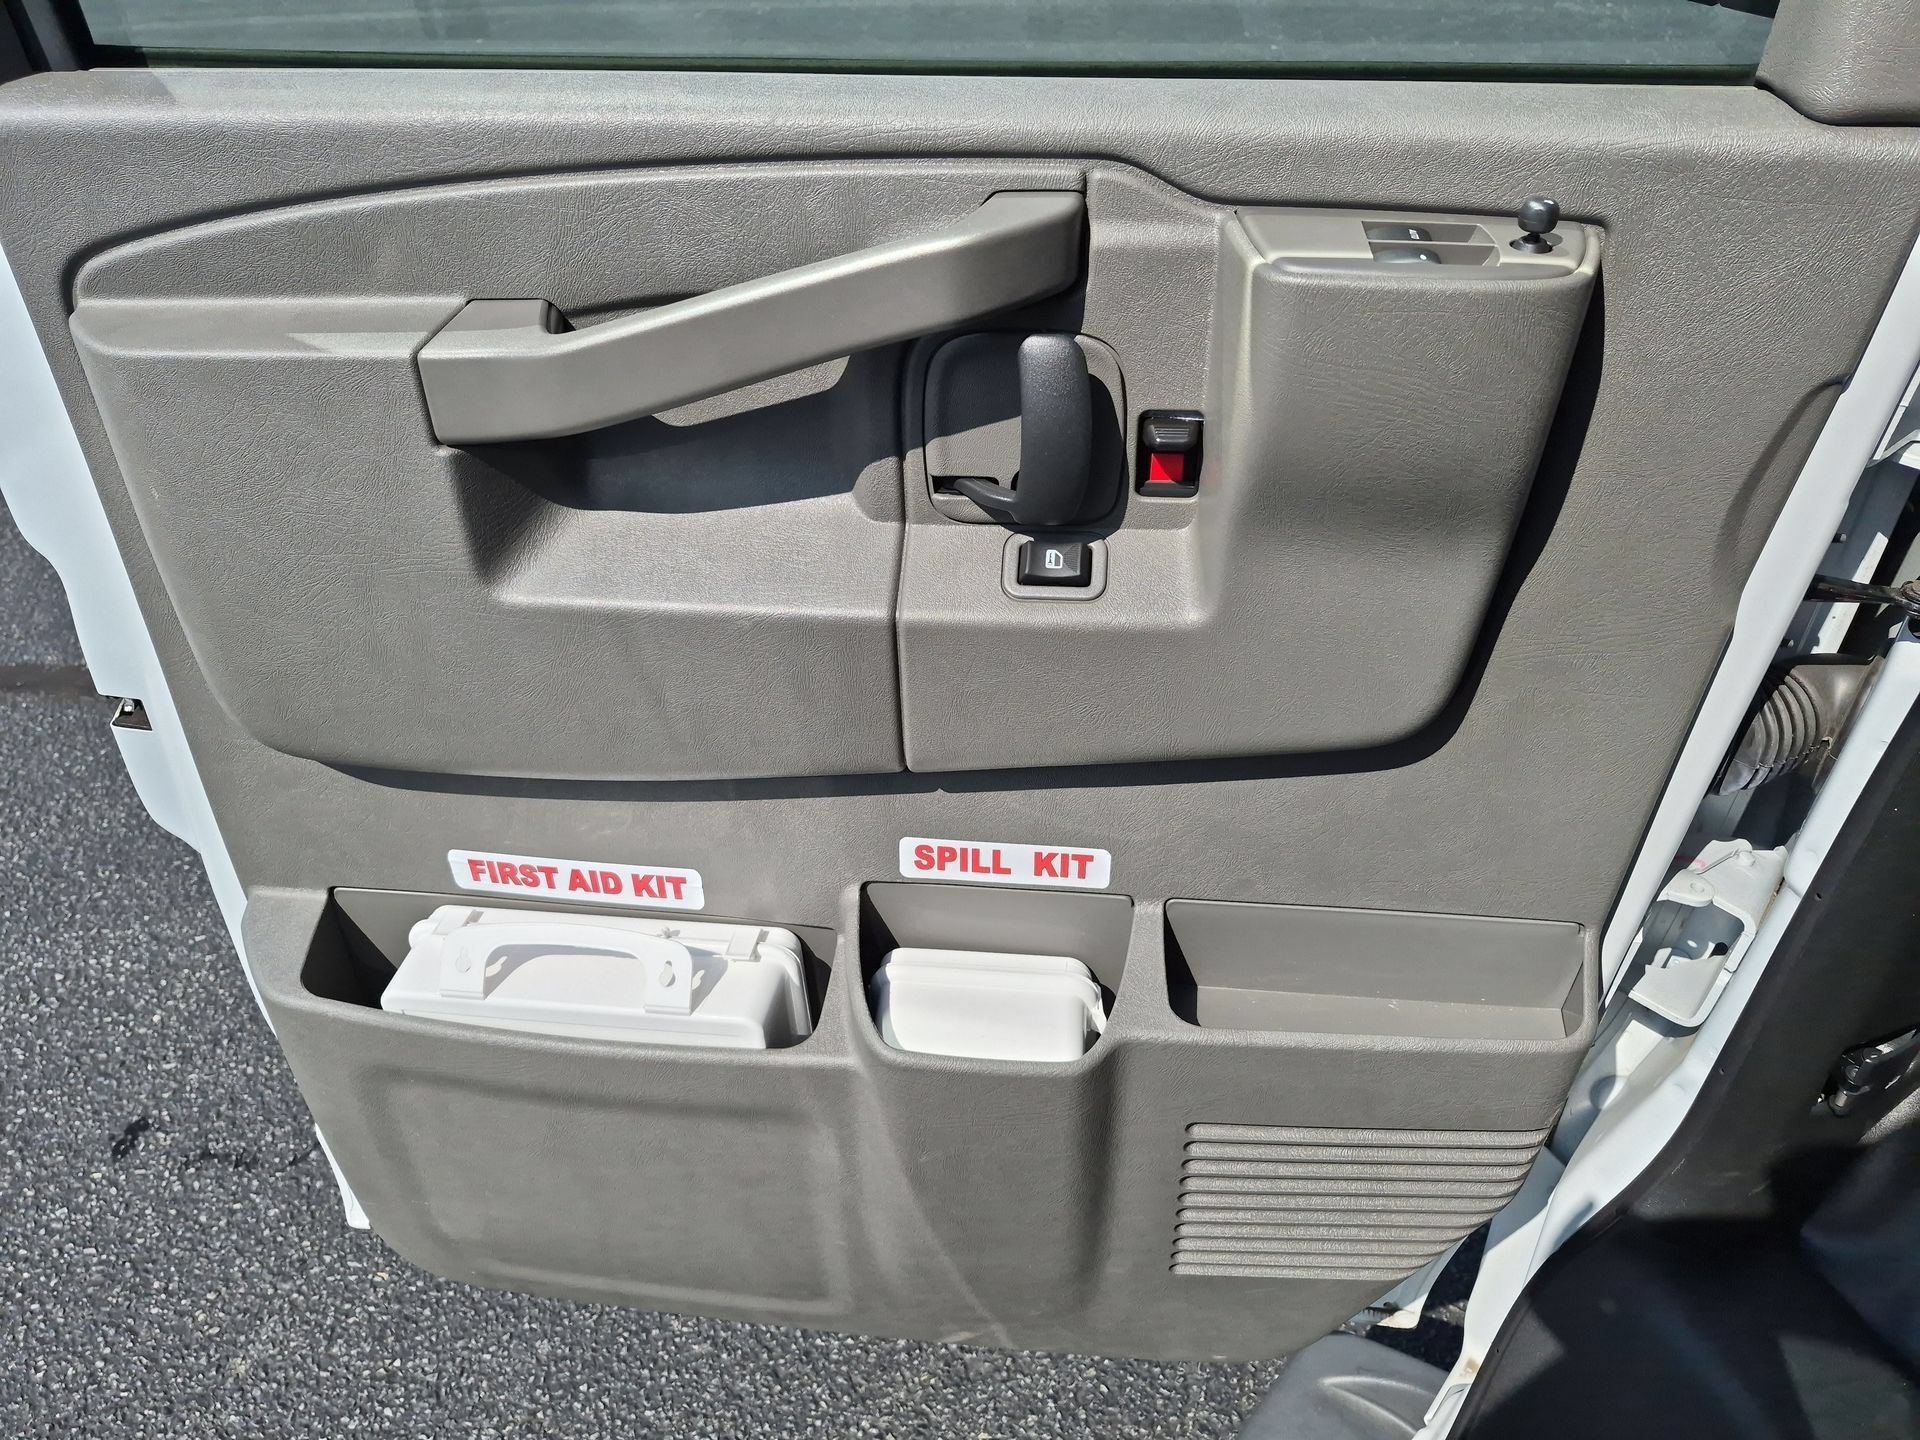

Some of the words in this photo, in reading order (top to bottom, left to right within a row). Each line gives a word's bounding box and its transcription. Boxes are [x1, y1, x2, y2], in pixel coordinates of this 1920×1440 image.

[467, 858, 557, 890] FIRST
[568, 868, 623, 895] AID
[631, 874, 688, 900] KIT
[914, 844, 1012, 876] SPILL
[1033, 851, 1095, 880] KIT
